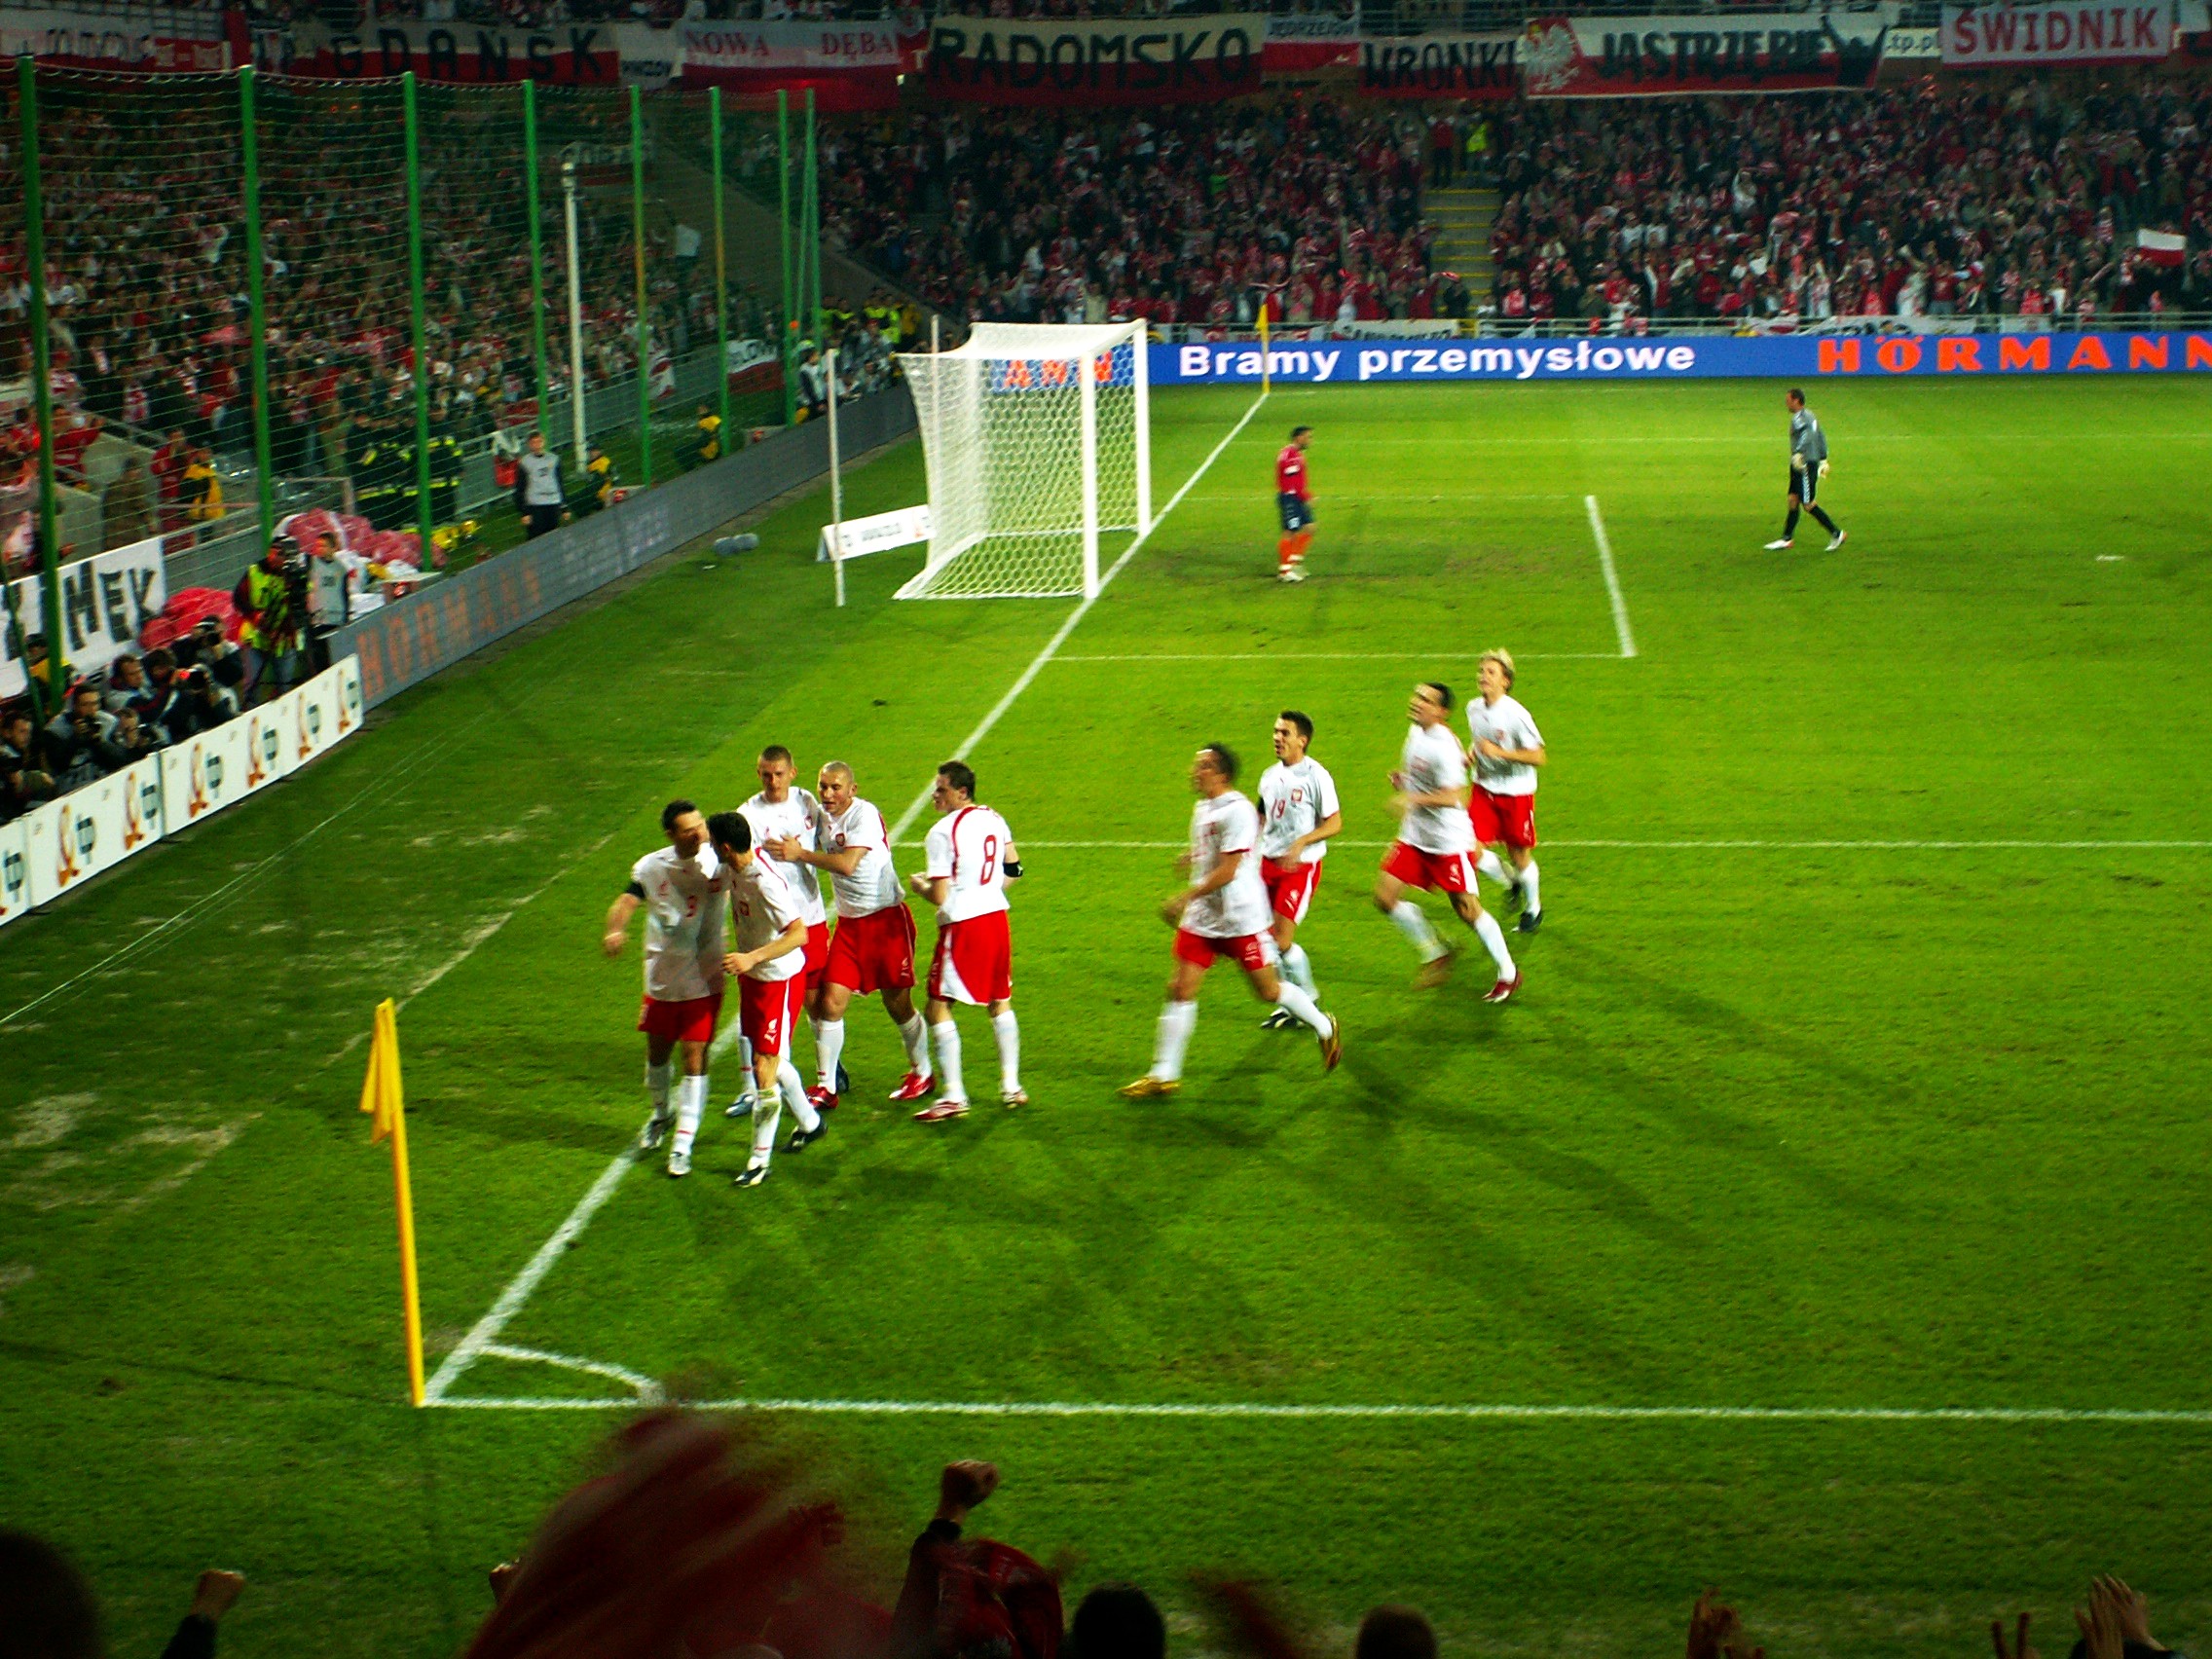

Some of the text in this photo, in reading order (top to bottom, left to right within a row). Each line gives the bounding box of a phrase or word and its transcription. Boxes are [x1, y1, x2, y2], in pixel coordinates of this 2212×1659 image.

[684, 31, 770, 56] NOWA
[1954, 4, 2158, 55] ŚWIDNIK
[930, 27, 1248, 90] RADOMSKO
[1364, 41, 1515, 89] WRONKI
[1179, 340, 1696, 381] Bramy przemysłowe
[1818, 335, 2212, 373] HÖRMANN
[1270, 798, 1286, 820] 19
[979, 834, 997, 885] 8
